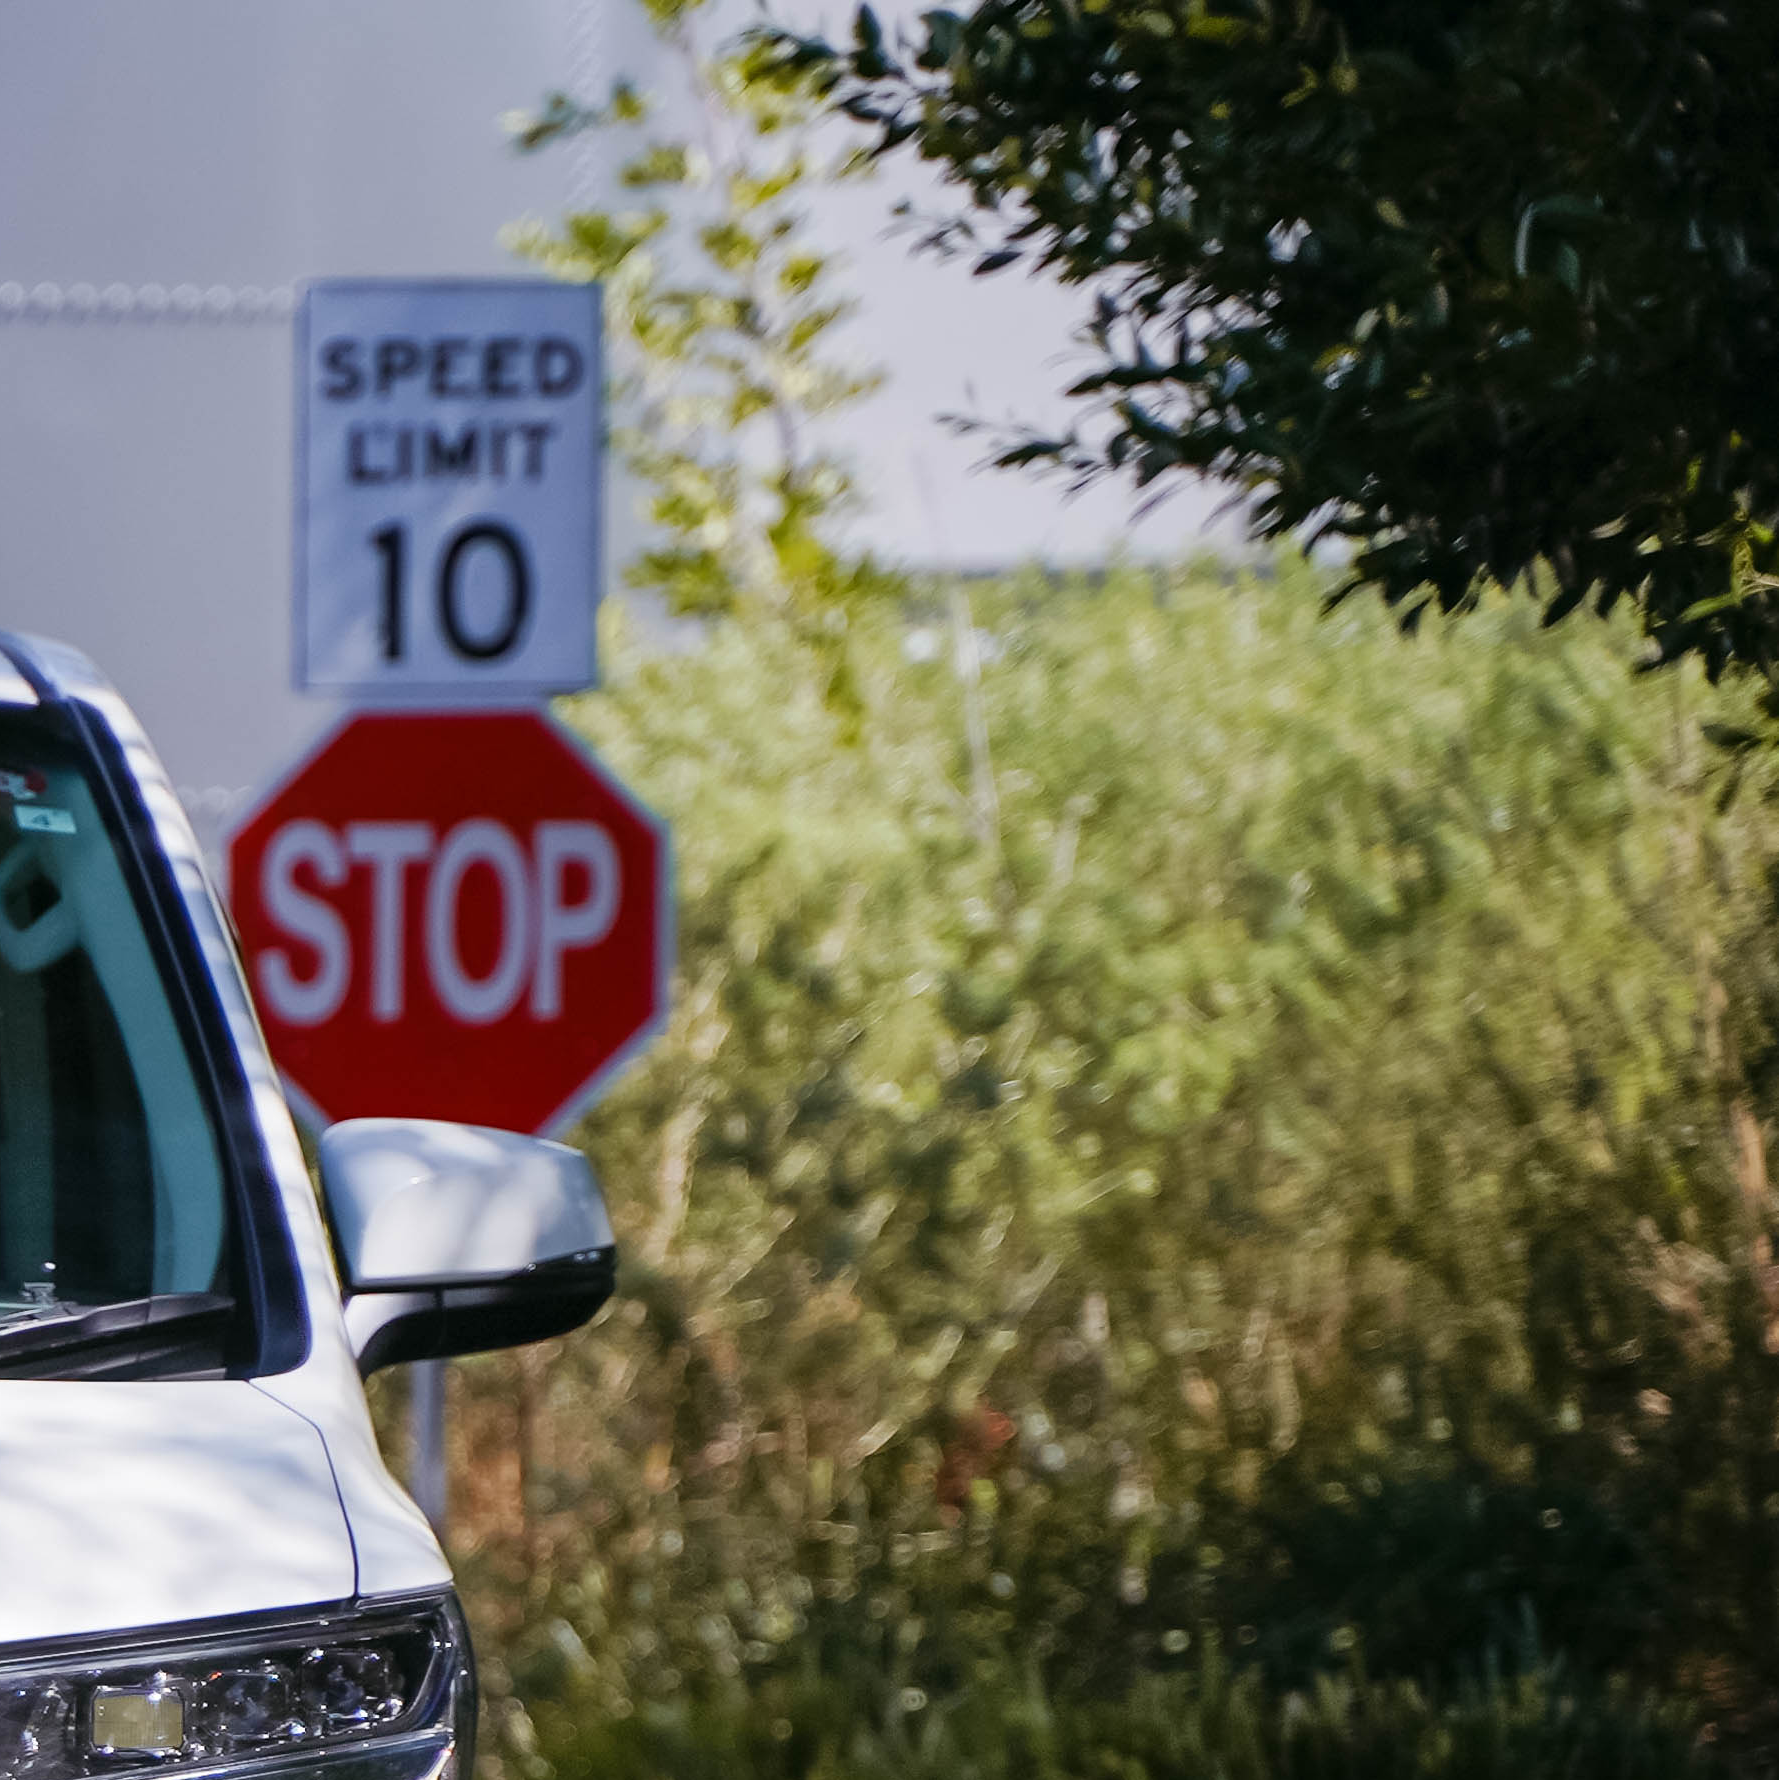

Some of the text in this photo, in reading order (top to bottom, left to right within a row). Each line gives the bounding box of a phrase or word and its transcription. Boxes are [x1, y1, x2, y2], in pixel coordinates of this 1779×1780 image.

[319, 335, 585, 401] SPEED
[346, 420, 559, 486] LIMIT
[368, 516, 537, 667] 10
[256, 816, 624, 1027] STOP
